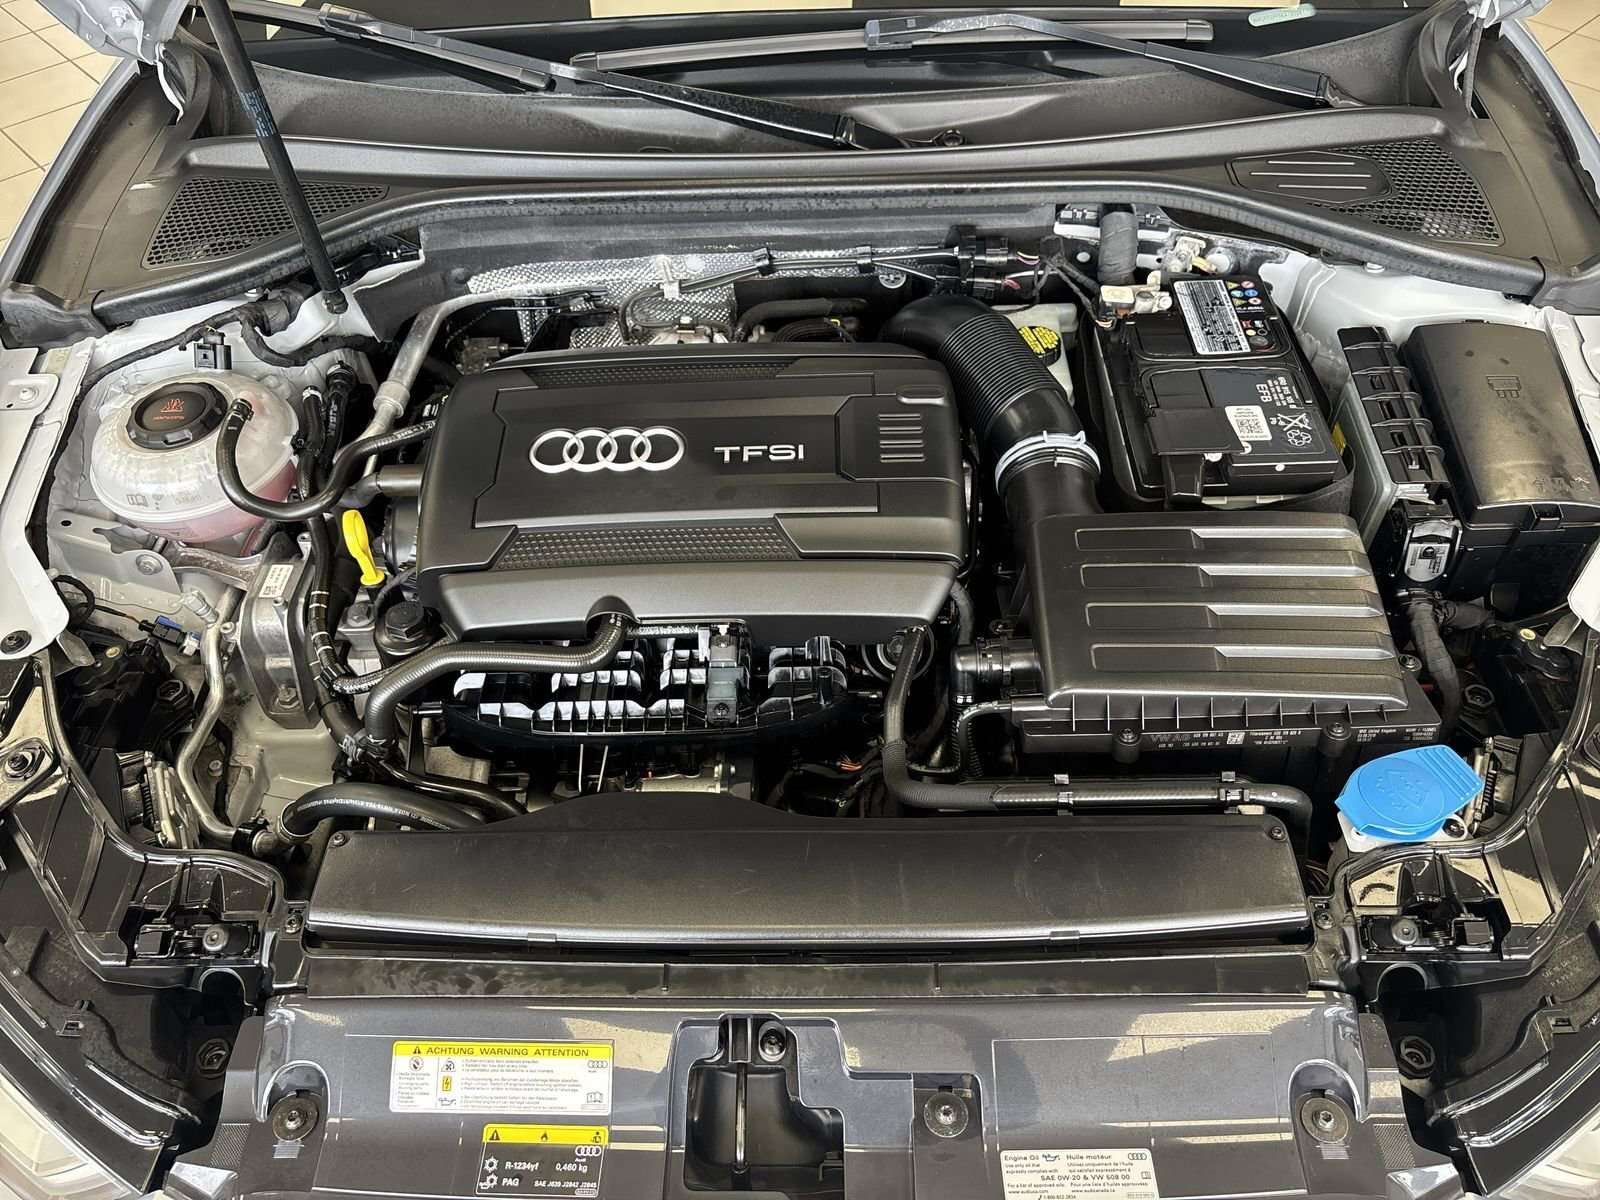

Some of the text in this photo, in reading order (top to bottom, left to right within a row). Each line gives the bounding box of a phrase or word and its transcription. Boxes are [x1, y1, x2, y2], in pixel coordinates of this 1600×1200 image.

[1256, 384, 1272, 402] EFB
[714, 444, 804, 464] TFSI
[426, 1047, 474, 1055] ACHTUNG
[480, 1048, 528, 1056] WARNING
[505, 1162, 539, 1172] R-1234yf
[578, 1163, 588, 1173] kg
[502, 1178, 520, 1186] PAG
